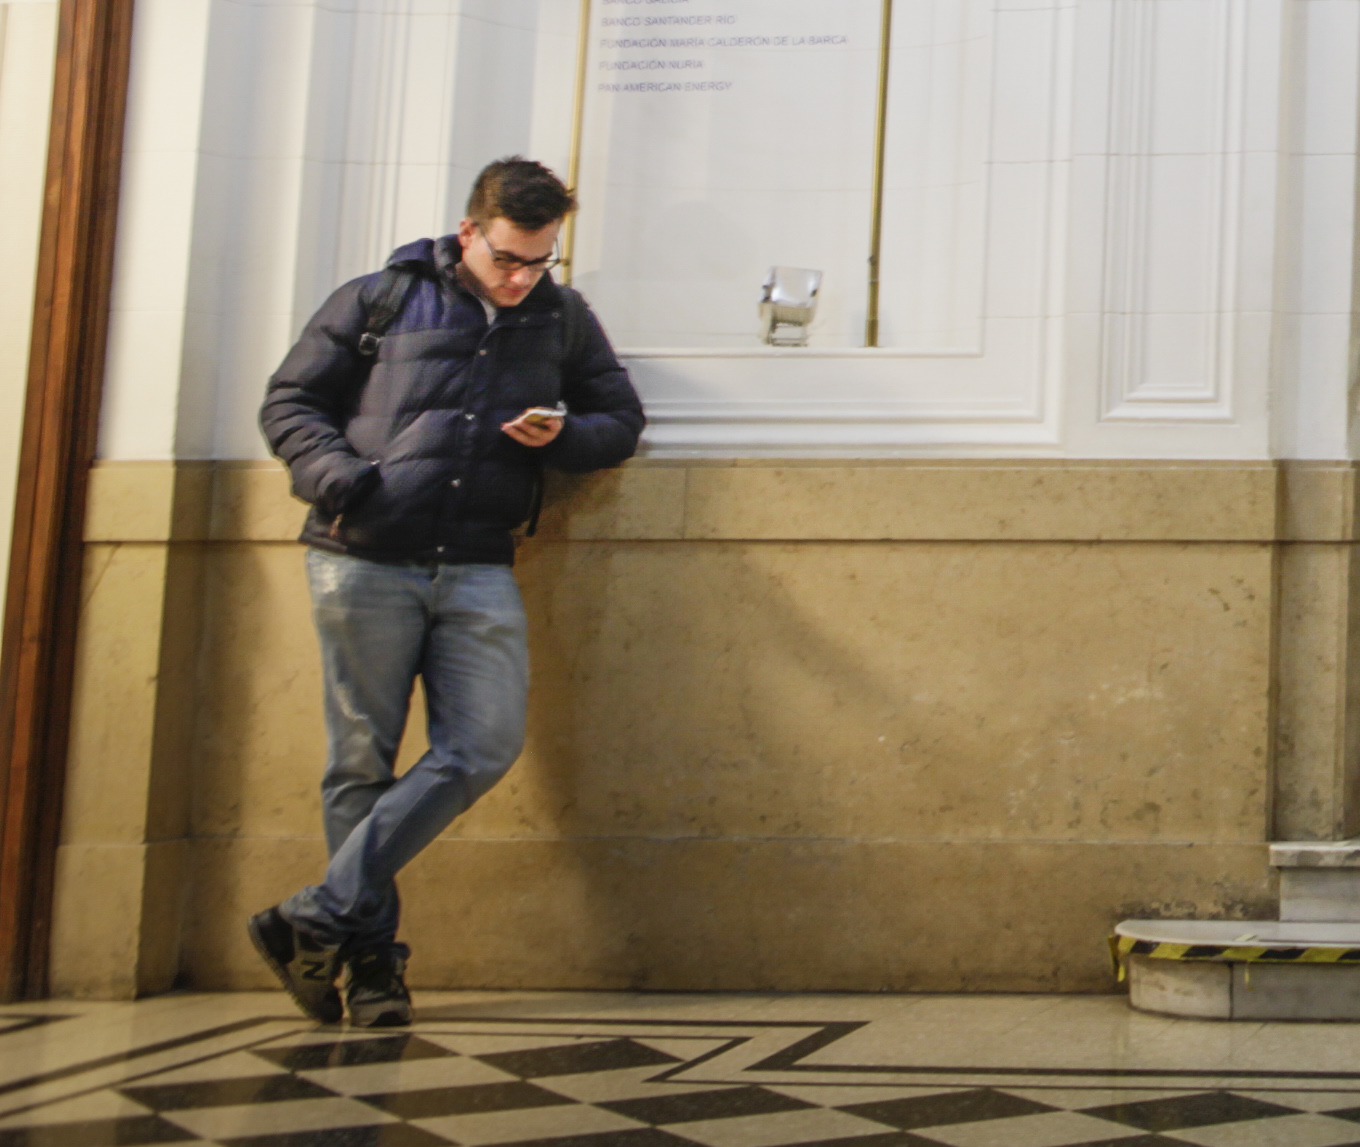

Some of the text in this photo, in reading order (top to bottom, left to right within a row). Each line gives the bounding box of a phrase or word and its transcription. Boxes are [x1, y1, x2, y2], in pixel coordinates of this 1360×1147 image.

[601, 16, 641, 27] BANCO
[645, 15, 712, 26] SANTANDER
[773, 34, 789, 46] DE
[792, 35, 806, 46] LA
[809, 34, 848, 45] BARCA
[598, 81, 733, 93] PAN AMERICAN ENERGY
[301, 959, 327, 981] N
